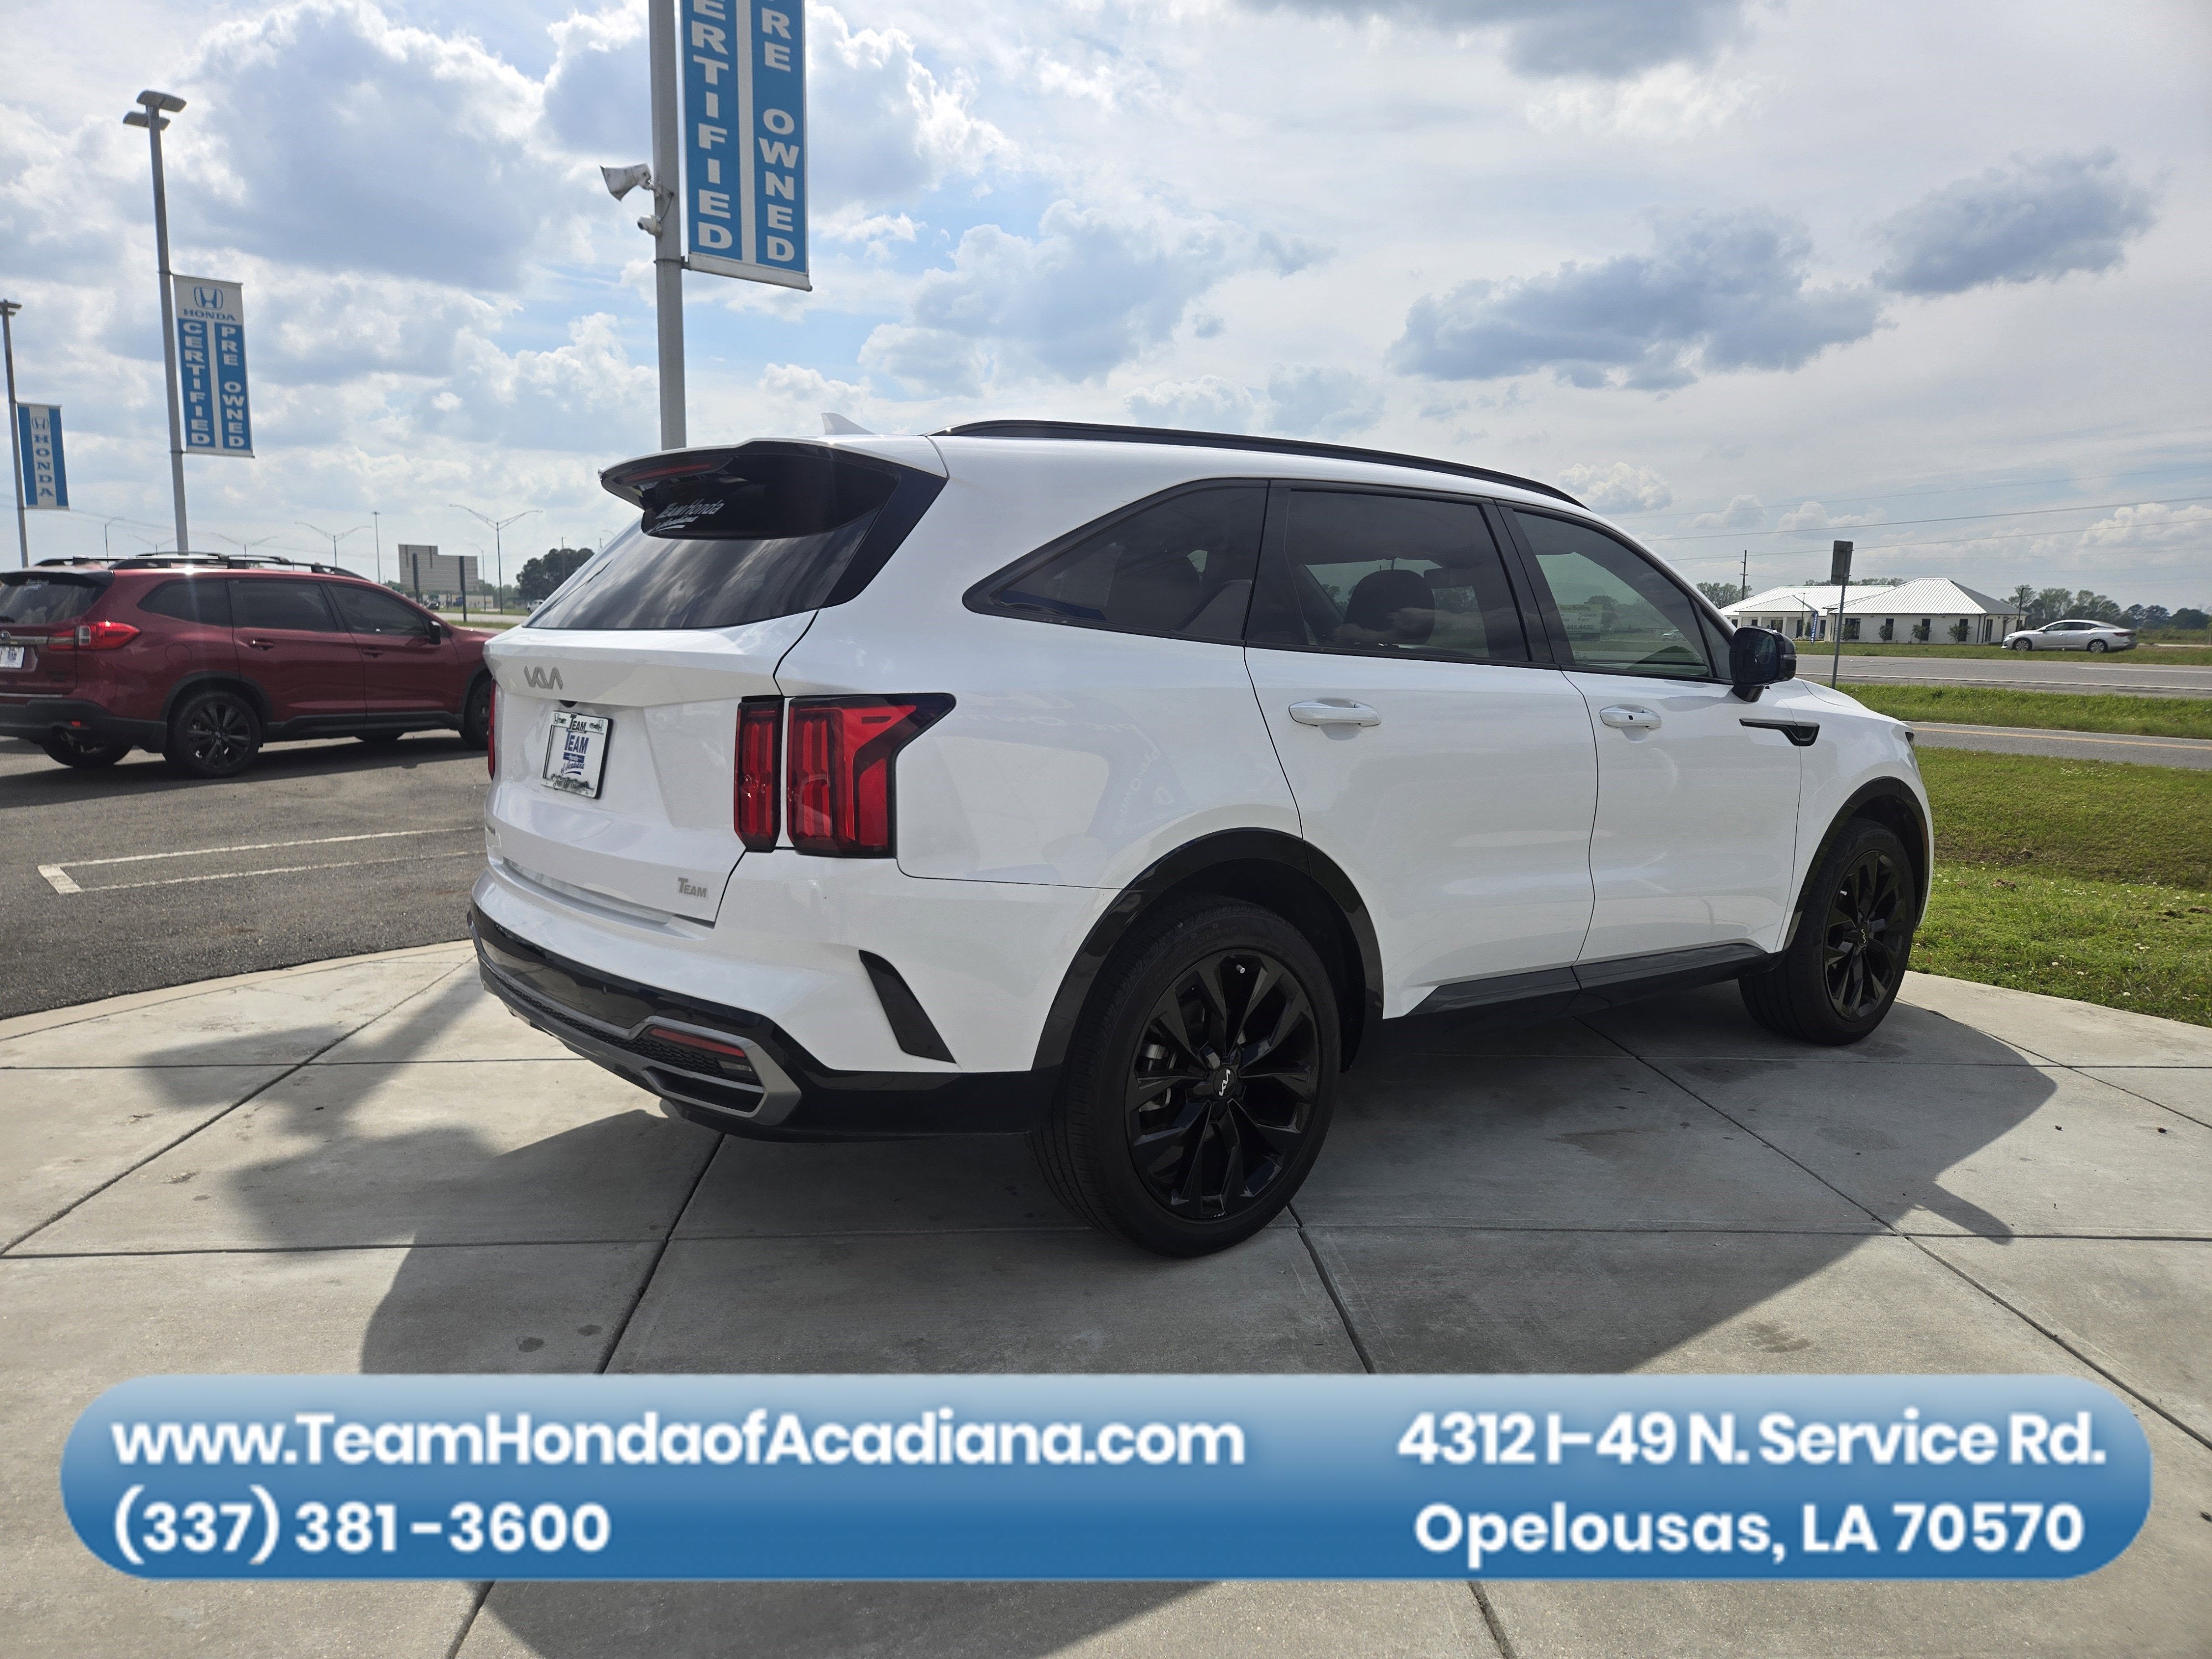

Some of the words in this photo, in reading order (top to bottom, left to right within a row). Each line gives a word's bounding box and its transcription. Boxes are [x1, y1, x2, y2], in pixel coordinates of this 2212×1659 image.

[761, 0, 792, 72] RE
[691, 0, 733, 249] ERTIFIED
[758, 108, 800, 263] OWNED
[183, 308, 236, 322] HONDA
[221, 326, 238, 367] PRE
[182, 322, 210, 445] CERTIFIED
[222, 380, 244, 448] OWNED
[34, 435, 54, 497] HONDA
